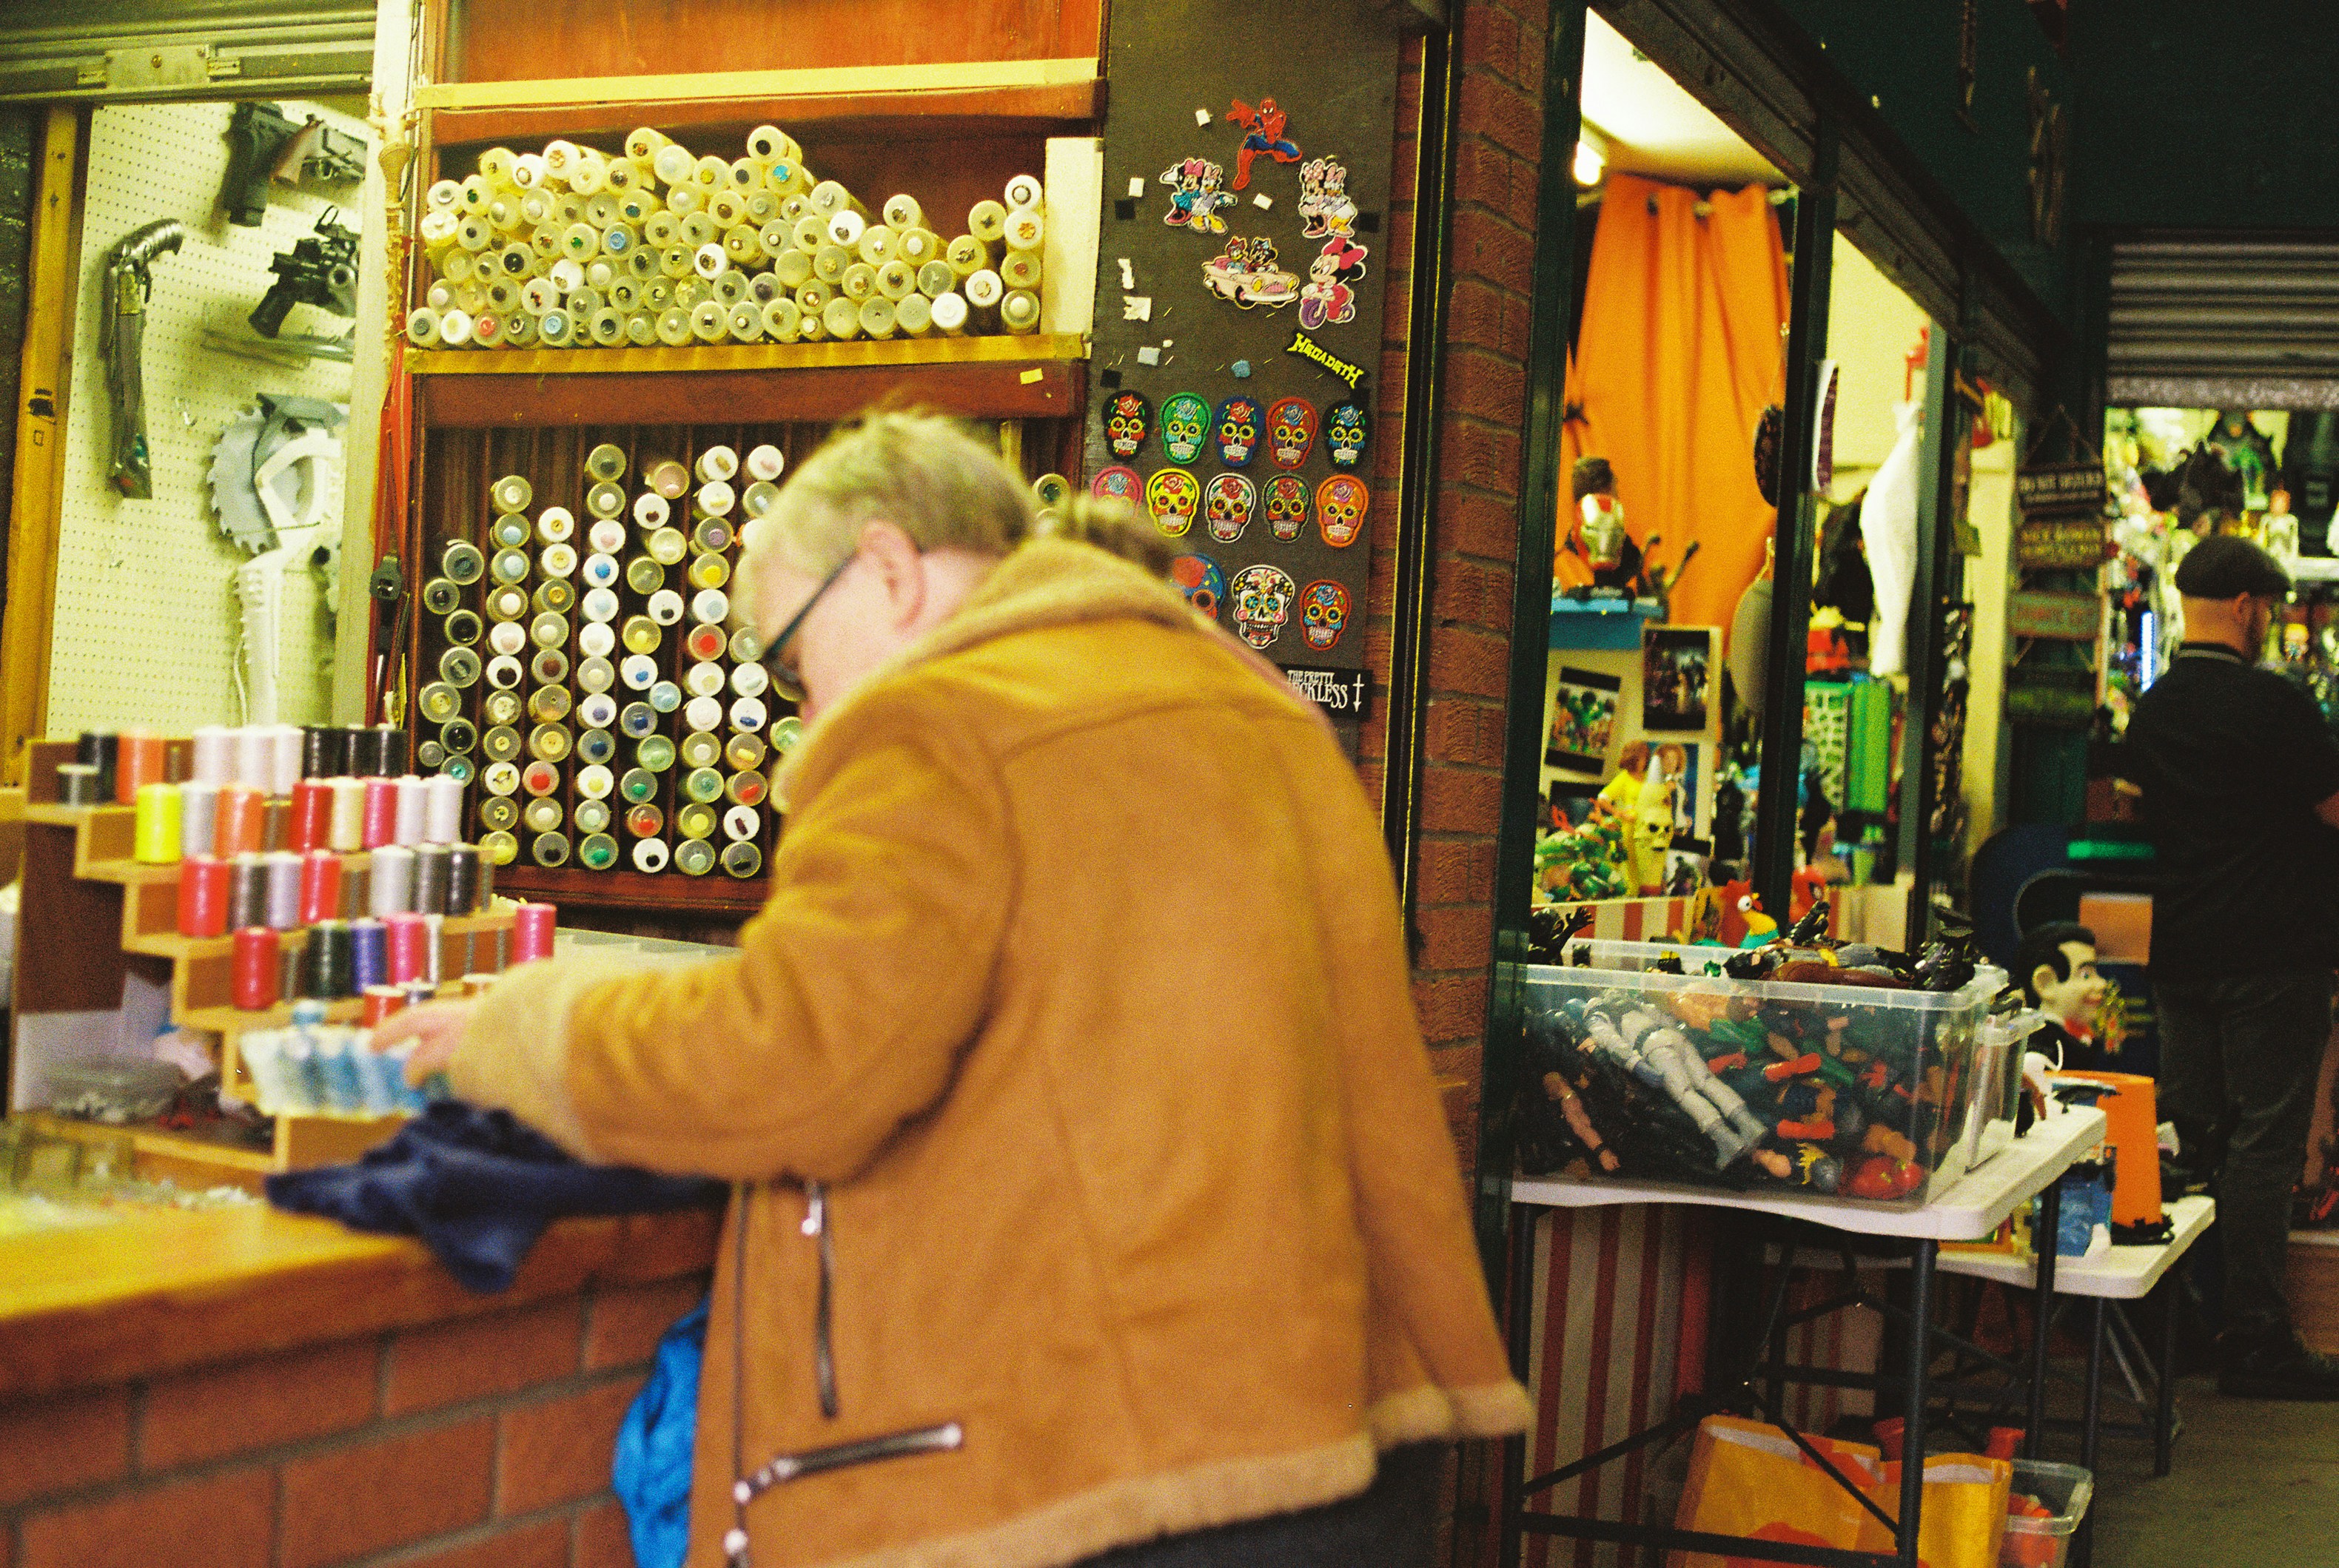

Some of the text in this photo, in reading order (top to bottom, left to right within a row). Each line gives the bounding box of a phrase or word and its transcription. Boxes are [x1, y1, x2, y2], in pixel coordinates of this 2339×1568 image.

[1286, 332, 1365, 389] MEGADETH
[1287, 670, 1335, 684] THE PRETTY
[1286, 682, 1348, 709] ECKLESS
